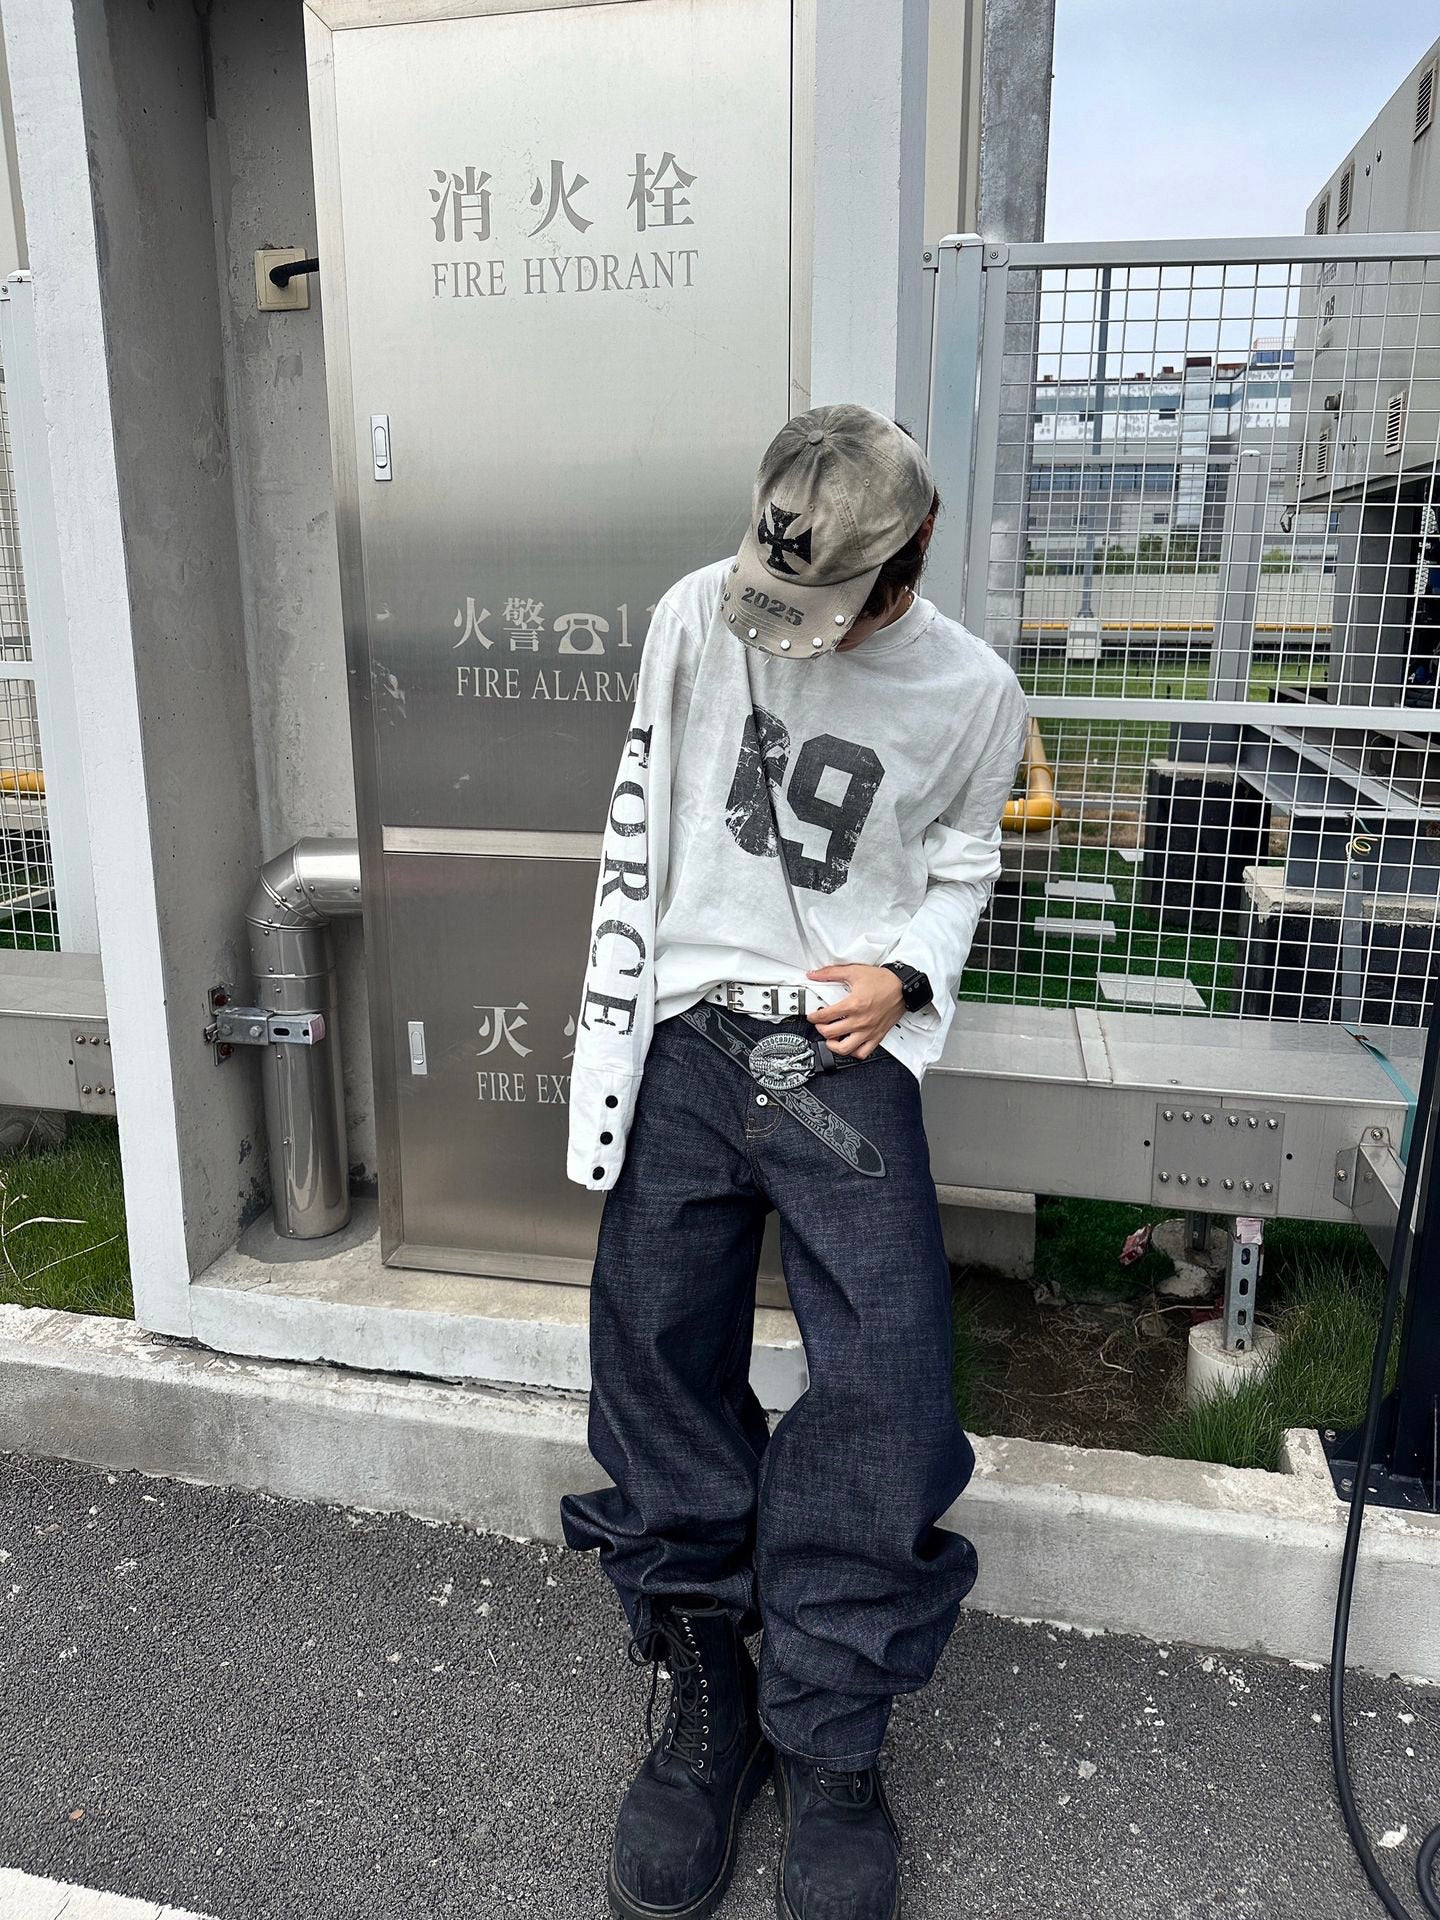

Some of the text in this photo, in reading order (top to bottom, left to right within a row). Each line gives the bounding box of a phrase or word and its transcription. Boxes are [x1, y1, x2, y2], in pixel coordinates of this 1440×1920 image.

[429, 151, 698, 242] 消火栓
[432, 249, 699, 299] FIRE HYDRANT
[453, 596, 657, 652] 火警 1
[741, 586, 805, 626] 2025
[456, 666, 639, 703] FIRE ALARM
[580, 724, 653, 1036] FORCE
[472, 1001, 575, 1060] 灭
[762, 1037, 800, 1047] CROCODILE
[476, 1071, 526, 1102] FIRE
[763, 1075, 800, 1087] COUNTRY
